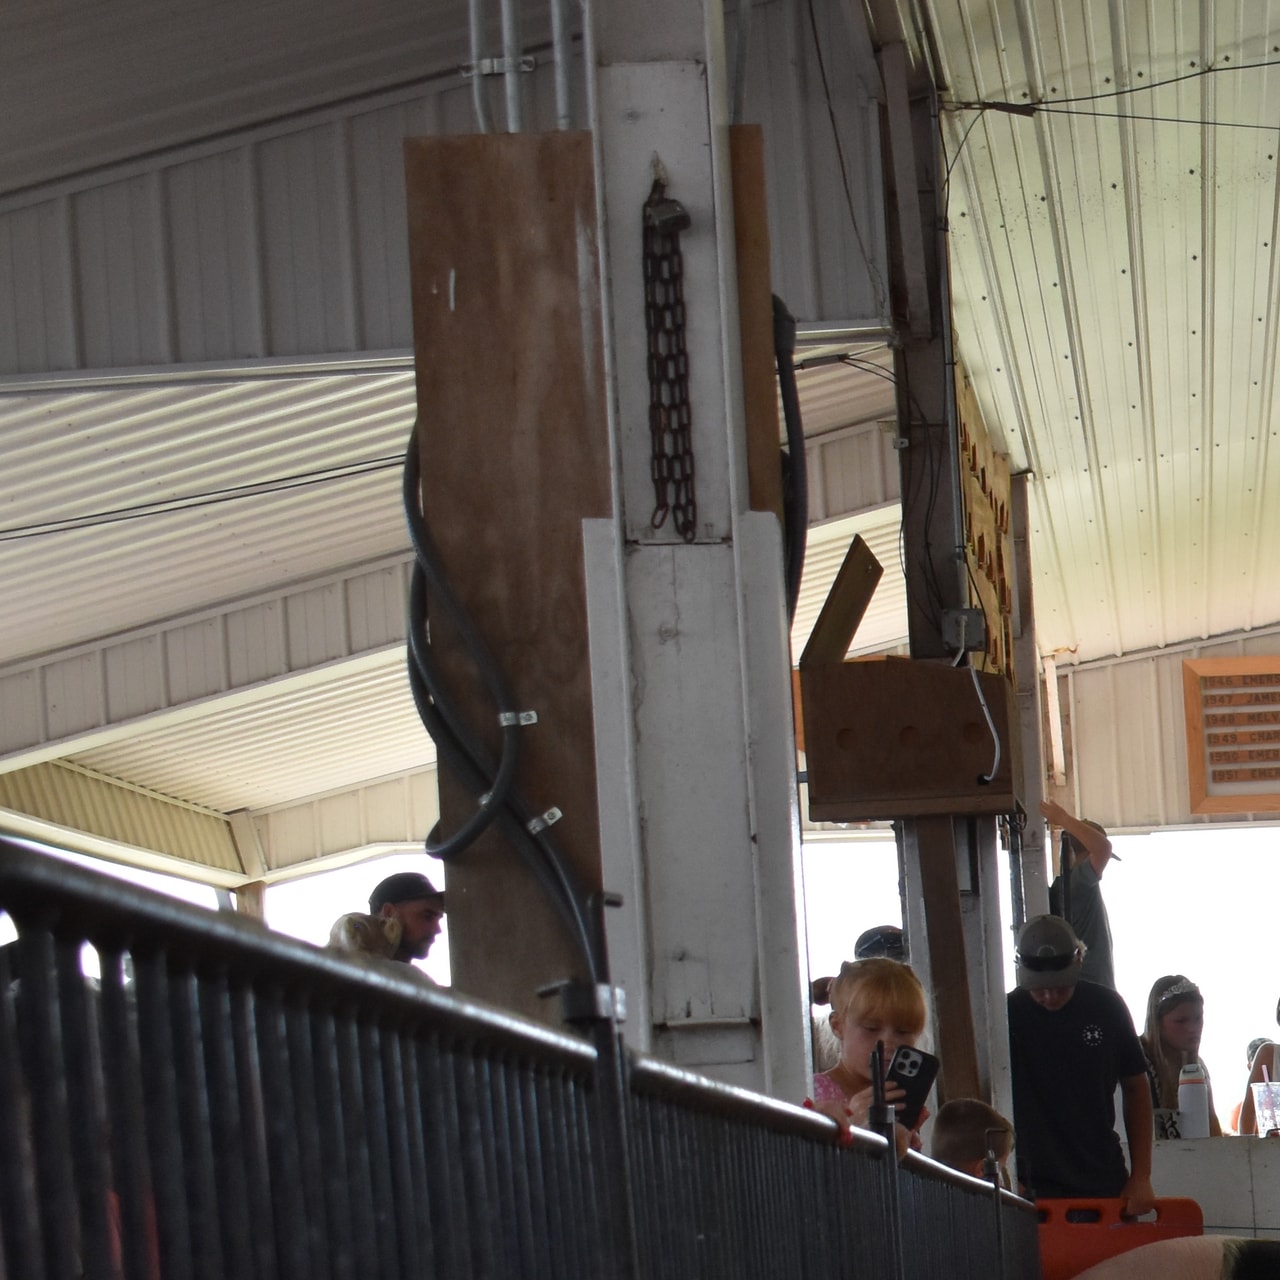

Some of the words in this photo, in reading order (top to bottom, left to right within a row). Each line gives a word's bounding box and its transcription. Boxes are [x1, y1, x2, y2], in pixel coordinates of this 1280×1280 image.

[1205, 693, 1233, 706] 1947
[1206, 712, 1236, 725] 1948
[1207, 732, 1238, 745] 1949
[1212, 769, 1240, 782] 1951
